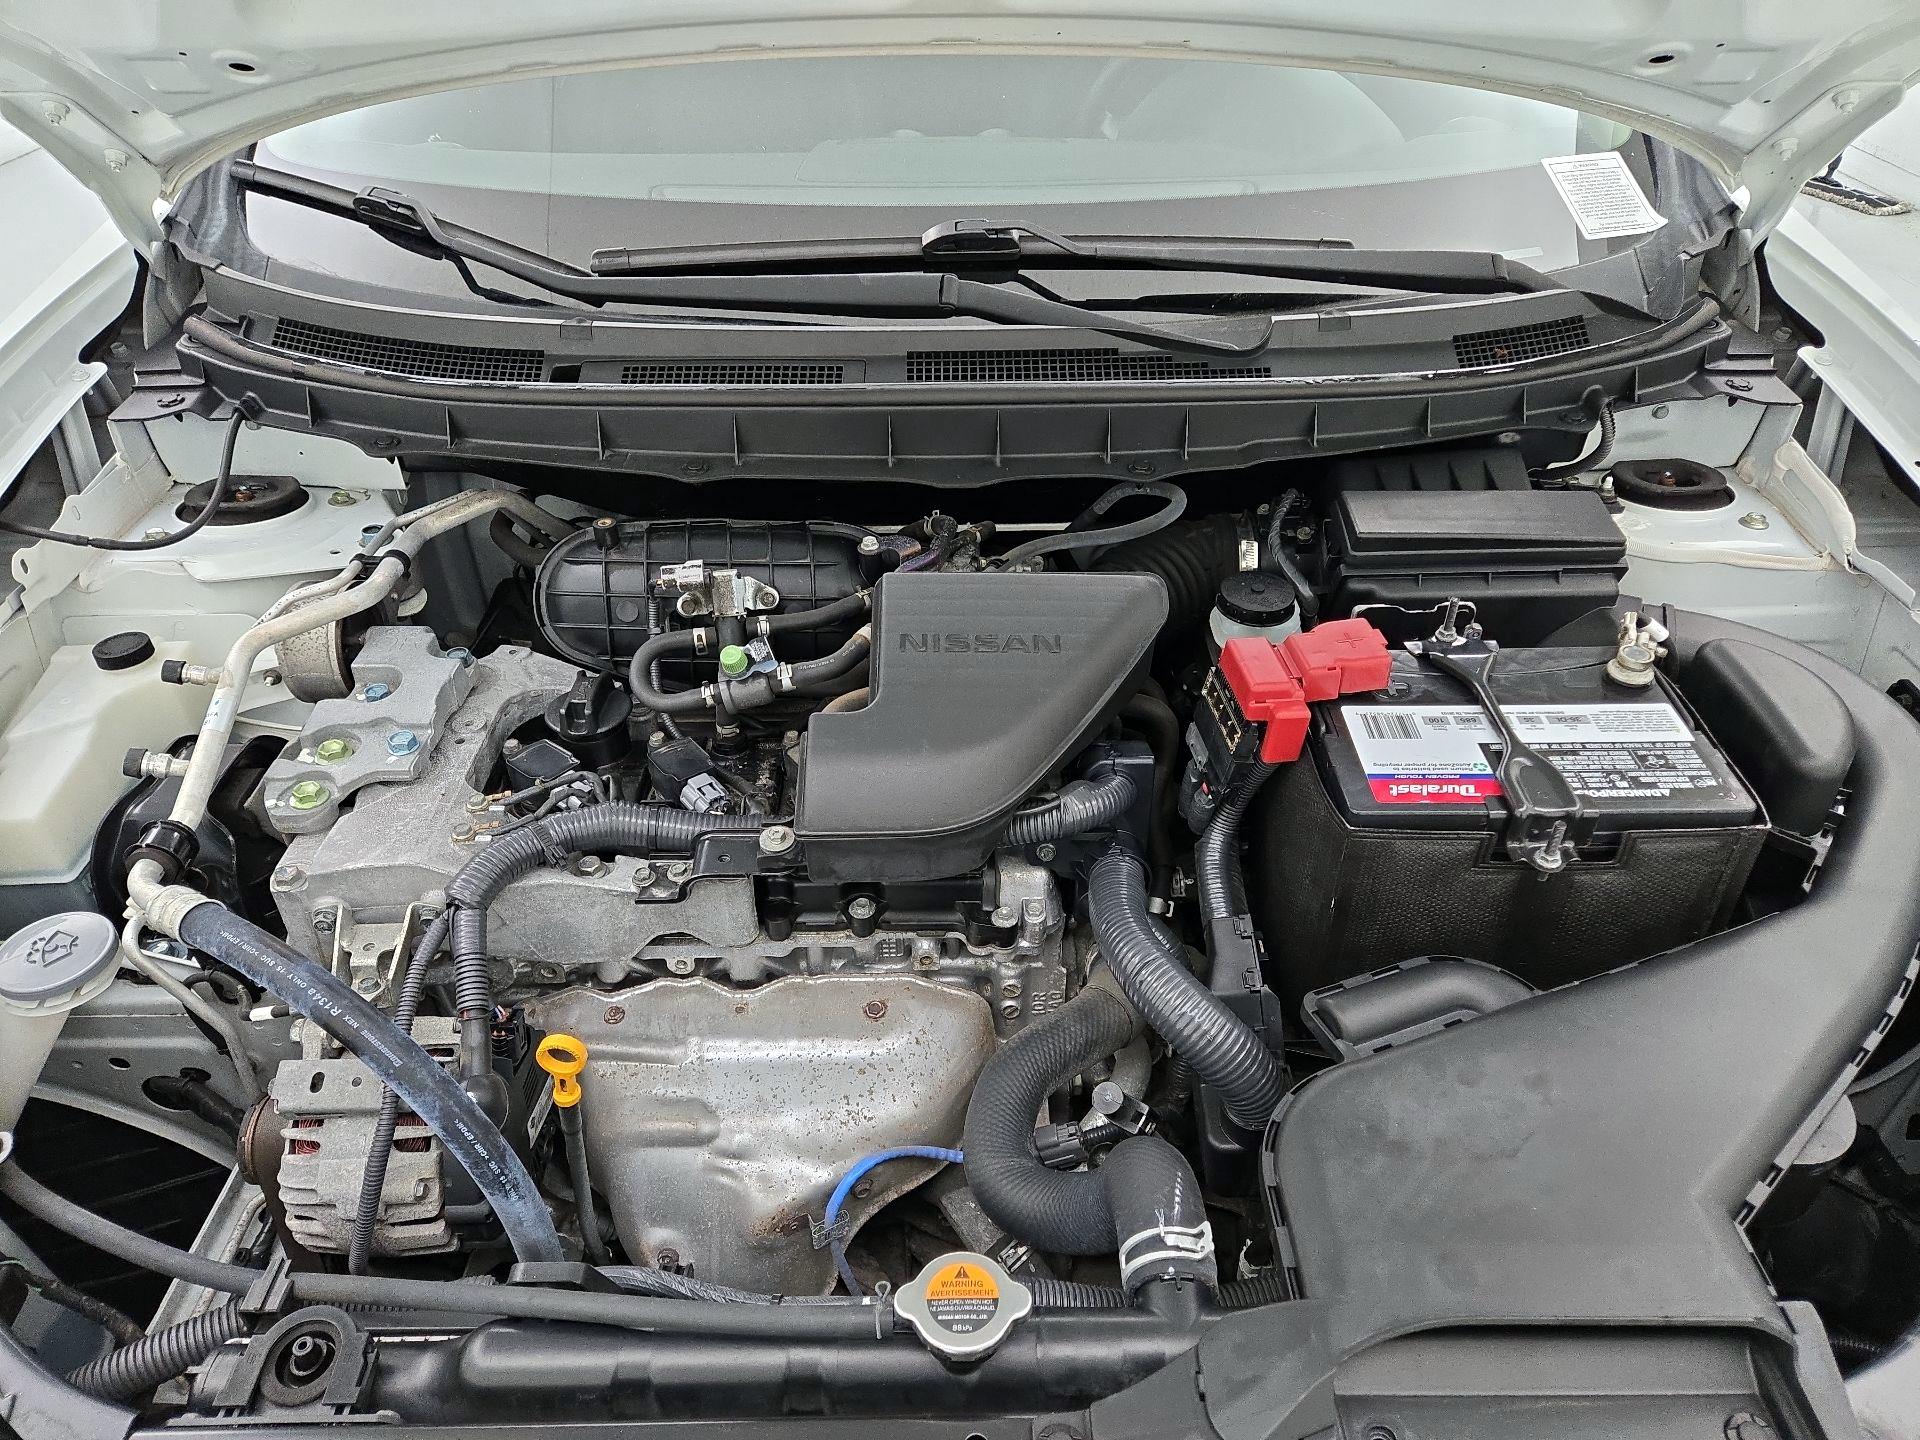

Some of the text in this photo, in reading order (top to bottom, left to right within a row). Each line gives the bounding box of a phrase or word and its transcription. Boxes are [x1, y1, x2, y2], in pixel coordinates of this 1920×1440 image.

[900, 633, 1062, 653] NISSAN
[1388, 784, 1482, 797] Duralast
[261, 954, 276, 966] SUC
[287, 973, 307, 988] ONLY
[308, 987, 342, 1016] R134a
[342, 1015, 360, 1029] NEX
[488, 1161, 500, 1175] SUC
